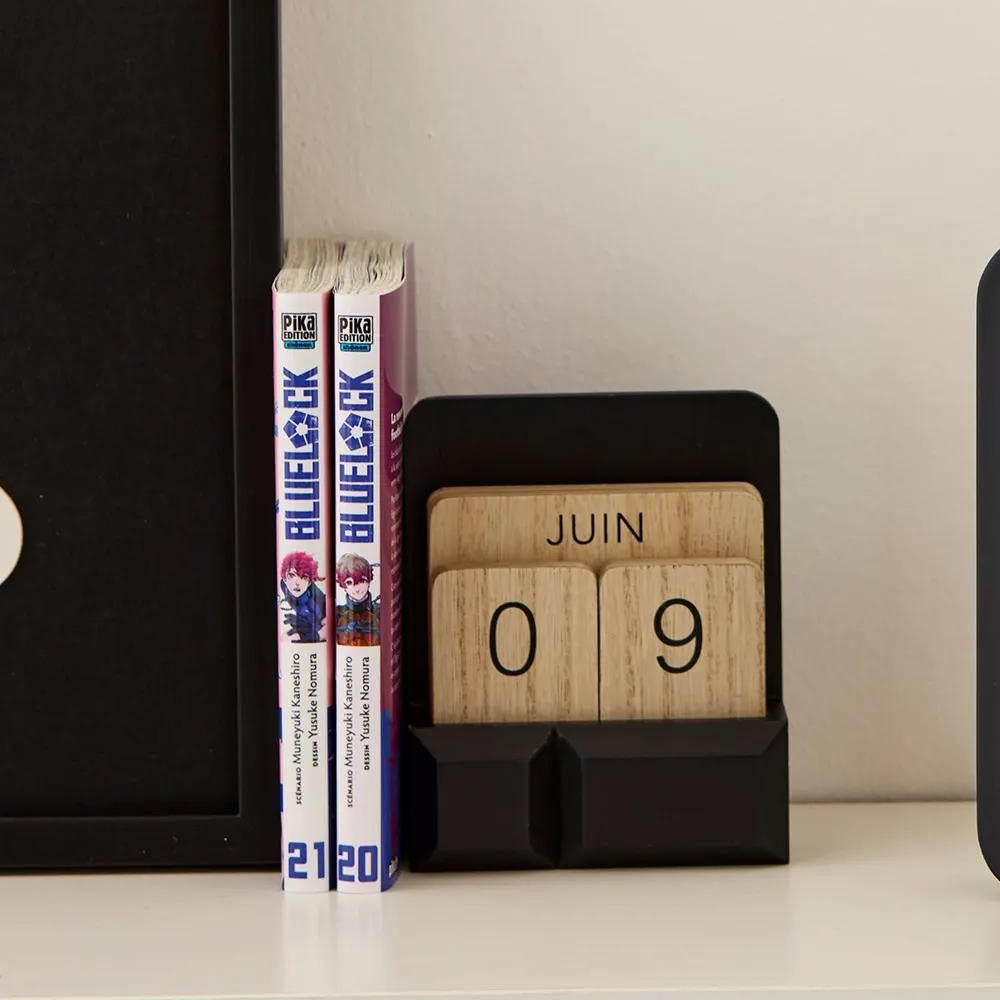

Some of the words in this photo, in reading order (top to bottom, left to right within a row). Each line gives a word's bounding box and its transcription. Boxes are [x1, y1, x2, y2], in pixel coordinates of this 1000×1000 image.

[547, 512, 644, 546] JUIN
[653, 598, 704, 674] 9
[291, 653, 301, 707] Kaneshiro
[308, 653, 317, 697] Nomura
[344, 656, 353, 710] Kaneshiro
[360, 656, 369, 700] Nomura
[291, 710, 303, 764] Muneyuki
[308, 700, 317, 738] Yusuke
[344, 713, 355, 767] Muneyuki
[360, 704, 370, 742] Yusuke
[288, 842, 325, 879] 21
[338, 844, 378, 882] 20
